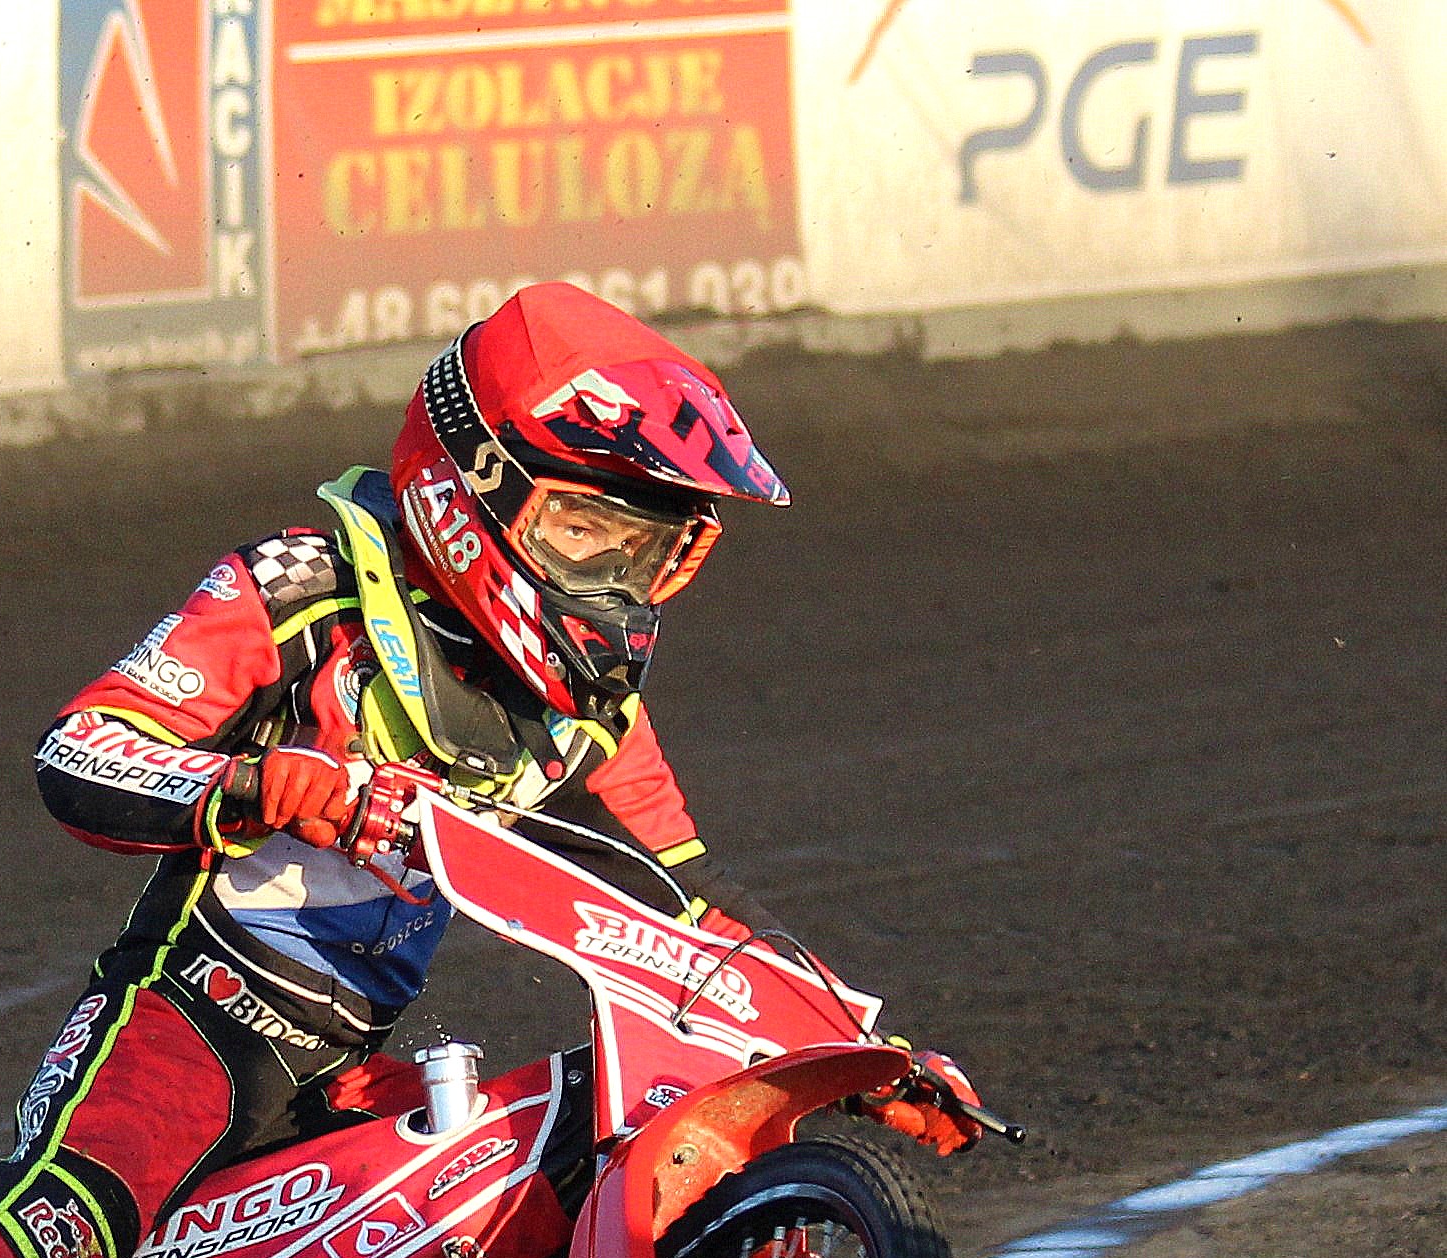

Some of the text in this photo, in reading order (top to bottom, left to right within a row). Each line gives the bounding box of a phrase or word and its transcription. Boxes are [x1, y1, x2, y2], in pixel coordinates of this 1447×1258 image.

[371, 49, 725, 136] IZOLACJE
[955, 31, 1262, 206] PGE
[42, 735, 208, 800] TRANSPORT
[584, 909, 747, 996] BINGO
[585, 935, 753, 1016] TRANSPORT
[152, 1168, 323, 1247] INGO
